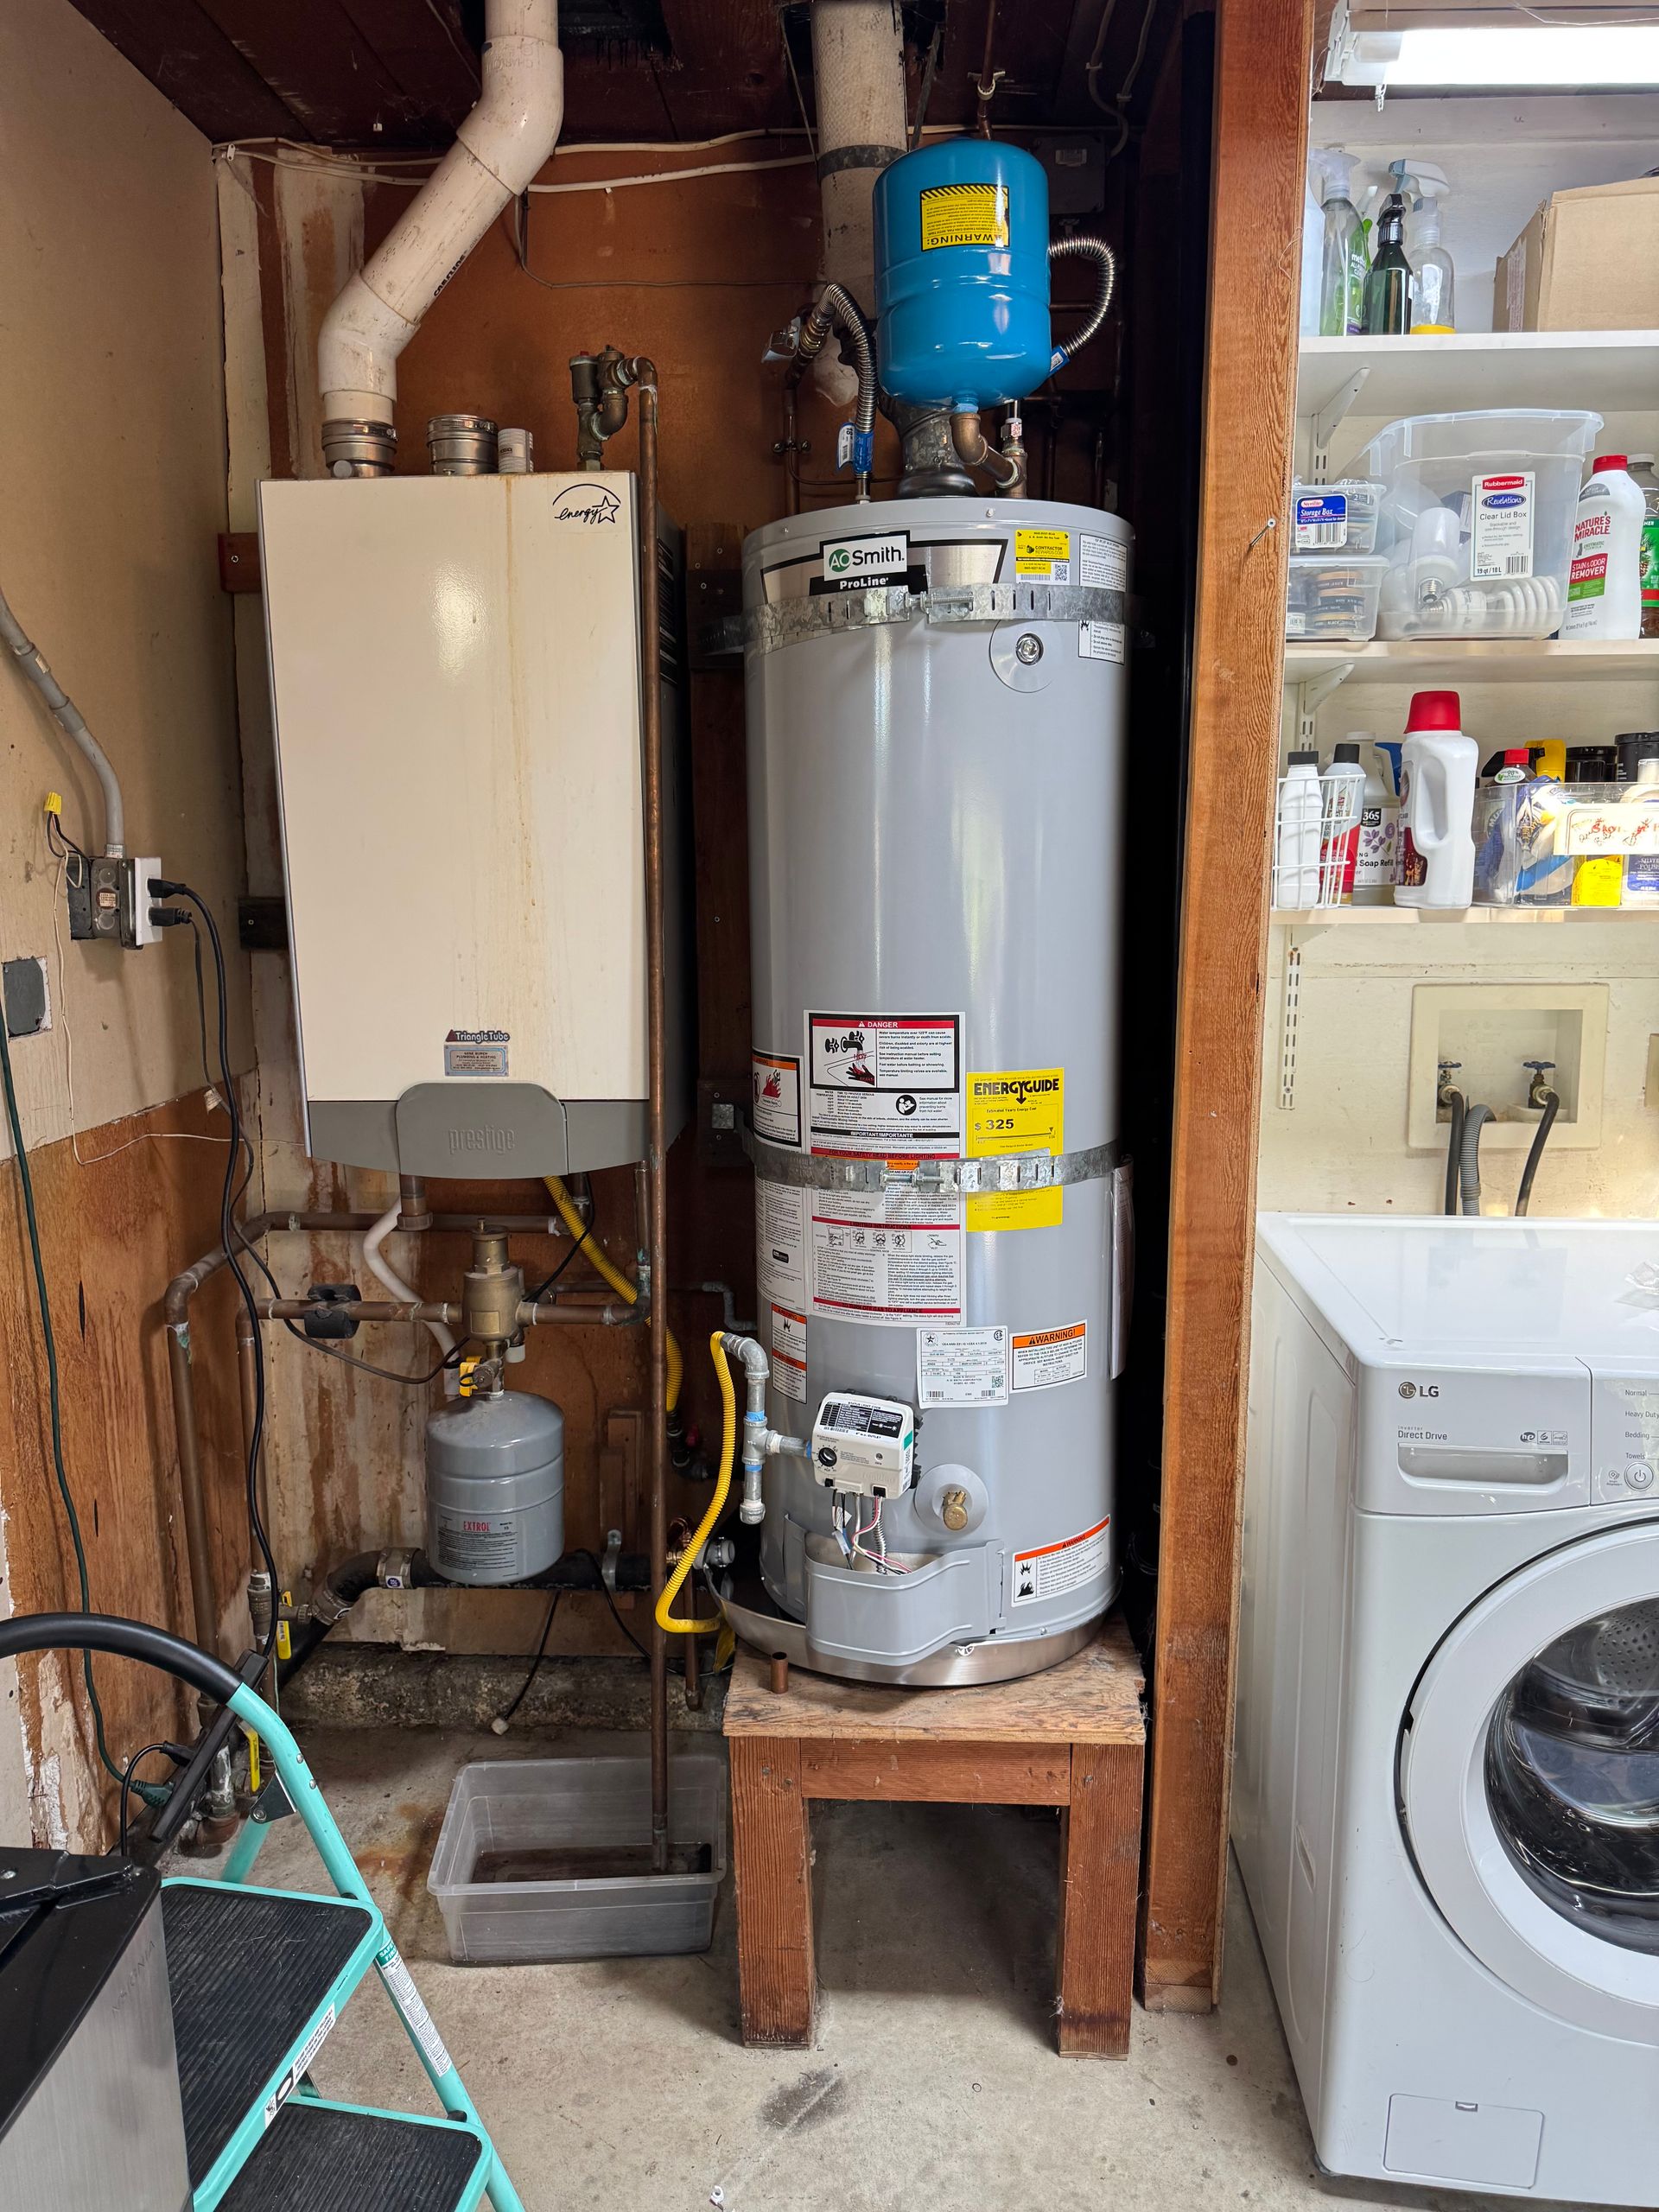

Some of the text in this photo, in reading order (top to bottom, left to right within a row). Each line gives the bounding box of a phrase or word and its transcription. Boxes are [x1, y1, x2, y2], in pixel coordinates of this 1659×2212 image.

[927, 234, 993, 245] WARNING:
[1487, 495, 1522, 505] Revelations
[554, 507, 600, 524] energy
[1575, 512, 1611, 532] NATURE'S
[1574, 525, 1611, 543] MIRACLE
[1572, 561, 1586, 572] STAIN
[1590, 557, 1605, 568] ODOR
[1571, 566, 1605, 580] REMOVER
[1363, 810, 1380, 821] 365
[985, 1119, 1014, 1130] 325
[1036, 1329, 1076, 1344] WARNING!
[1420, 1386, 1440, 1397] LG
[1398, 1430, 1447, 1440] Direct Drive
[463, 1521, 490, 1532] EXTROL
